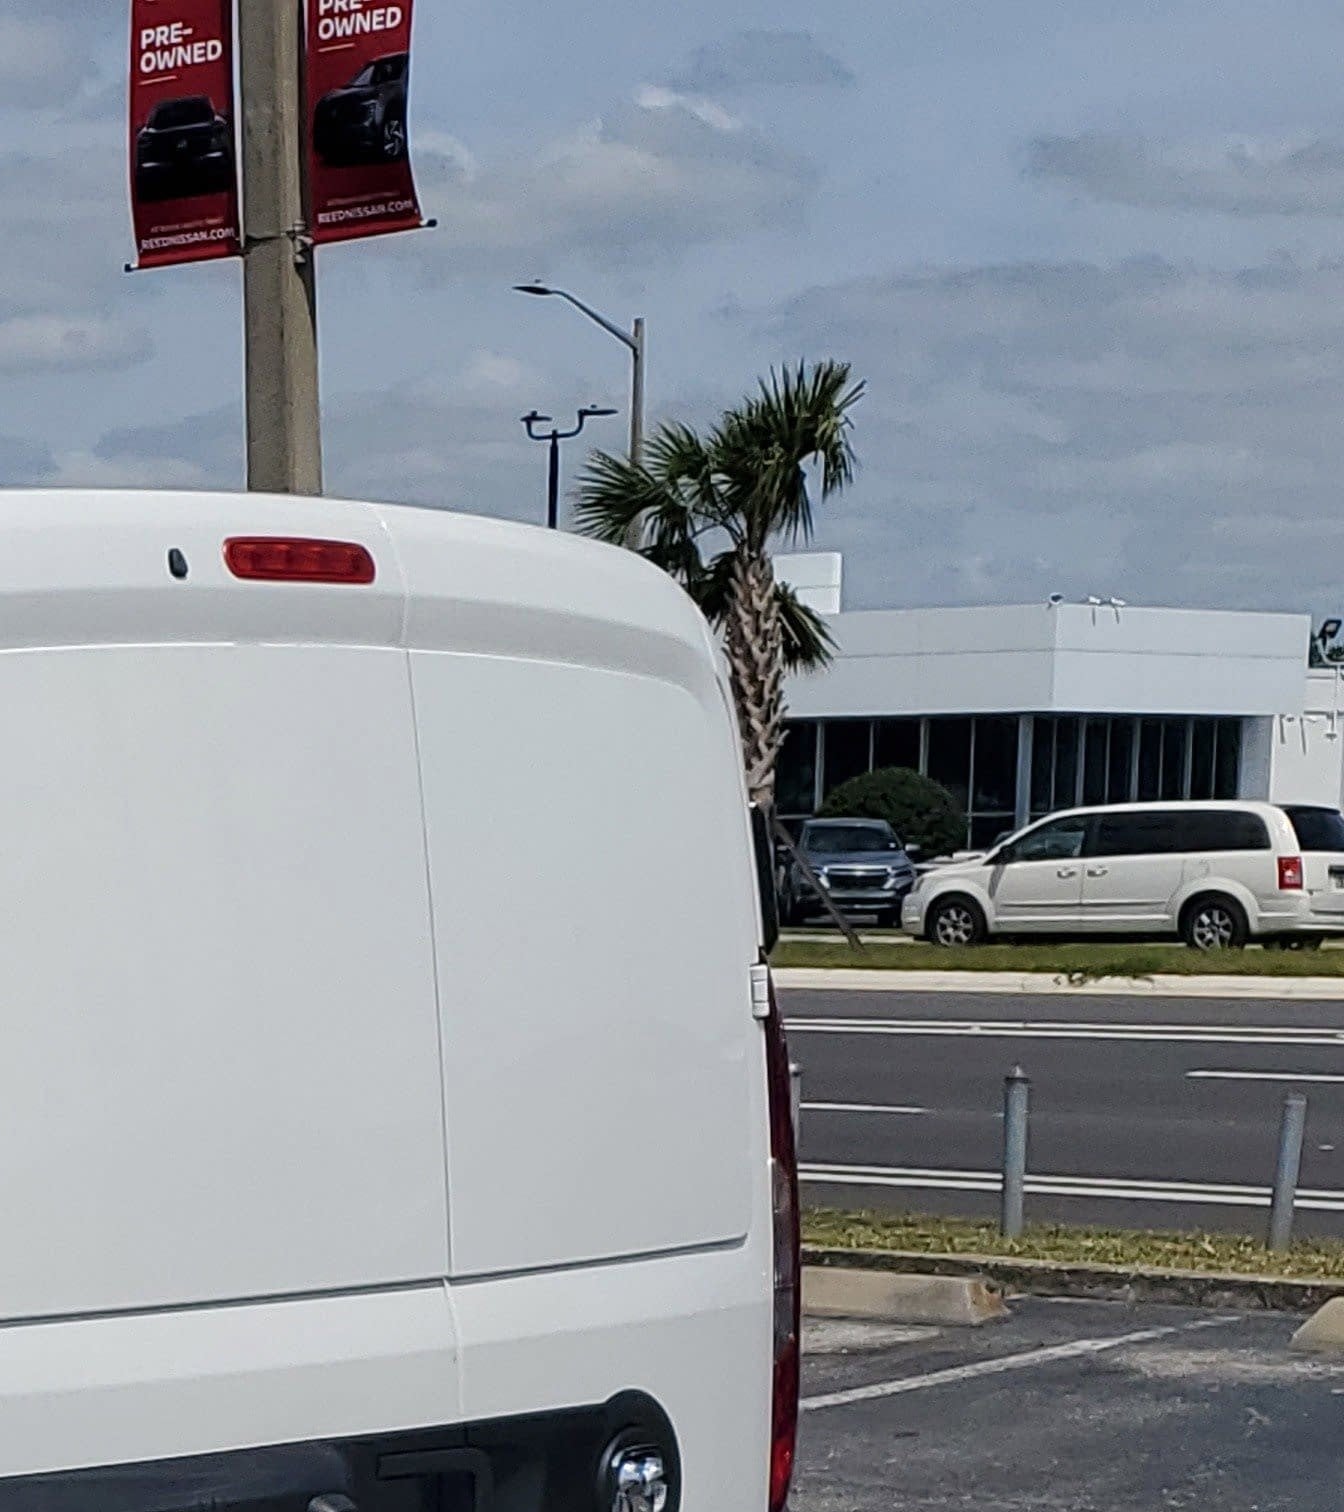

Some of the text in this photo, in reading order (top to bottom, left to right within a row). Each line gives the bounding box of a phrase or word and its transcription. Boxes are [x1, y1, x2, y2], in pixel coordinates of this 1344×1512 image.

[140, 21, 193, 50] PRE-
[318, 6, 402, 40] OWNED
[139, 39, 223, 73] OWNED
